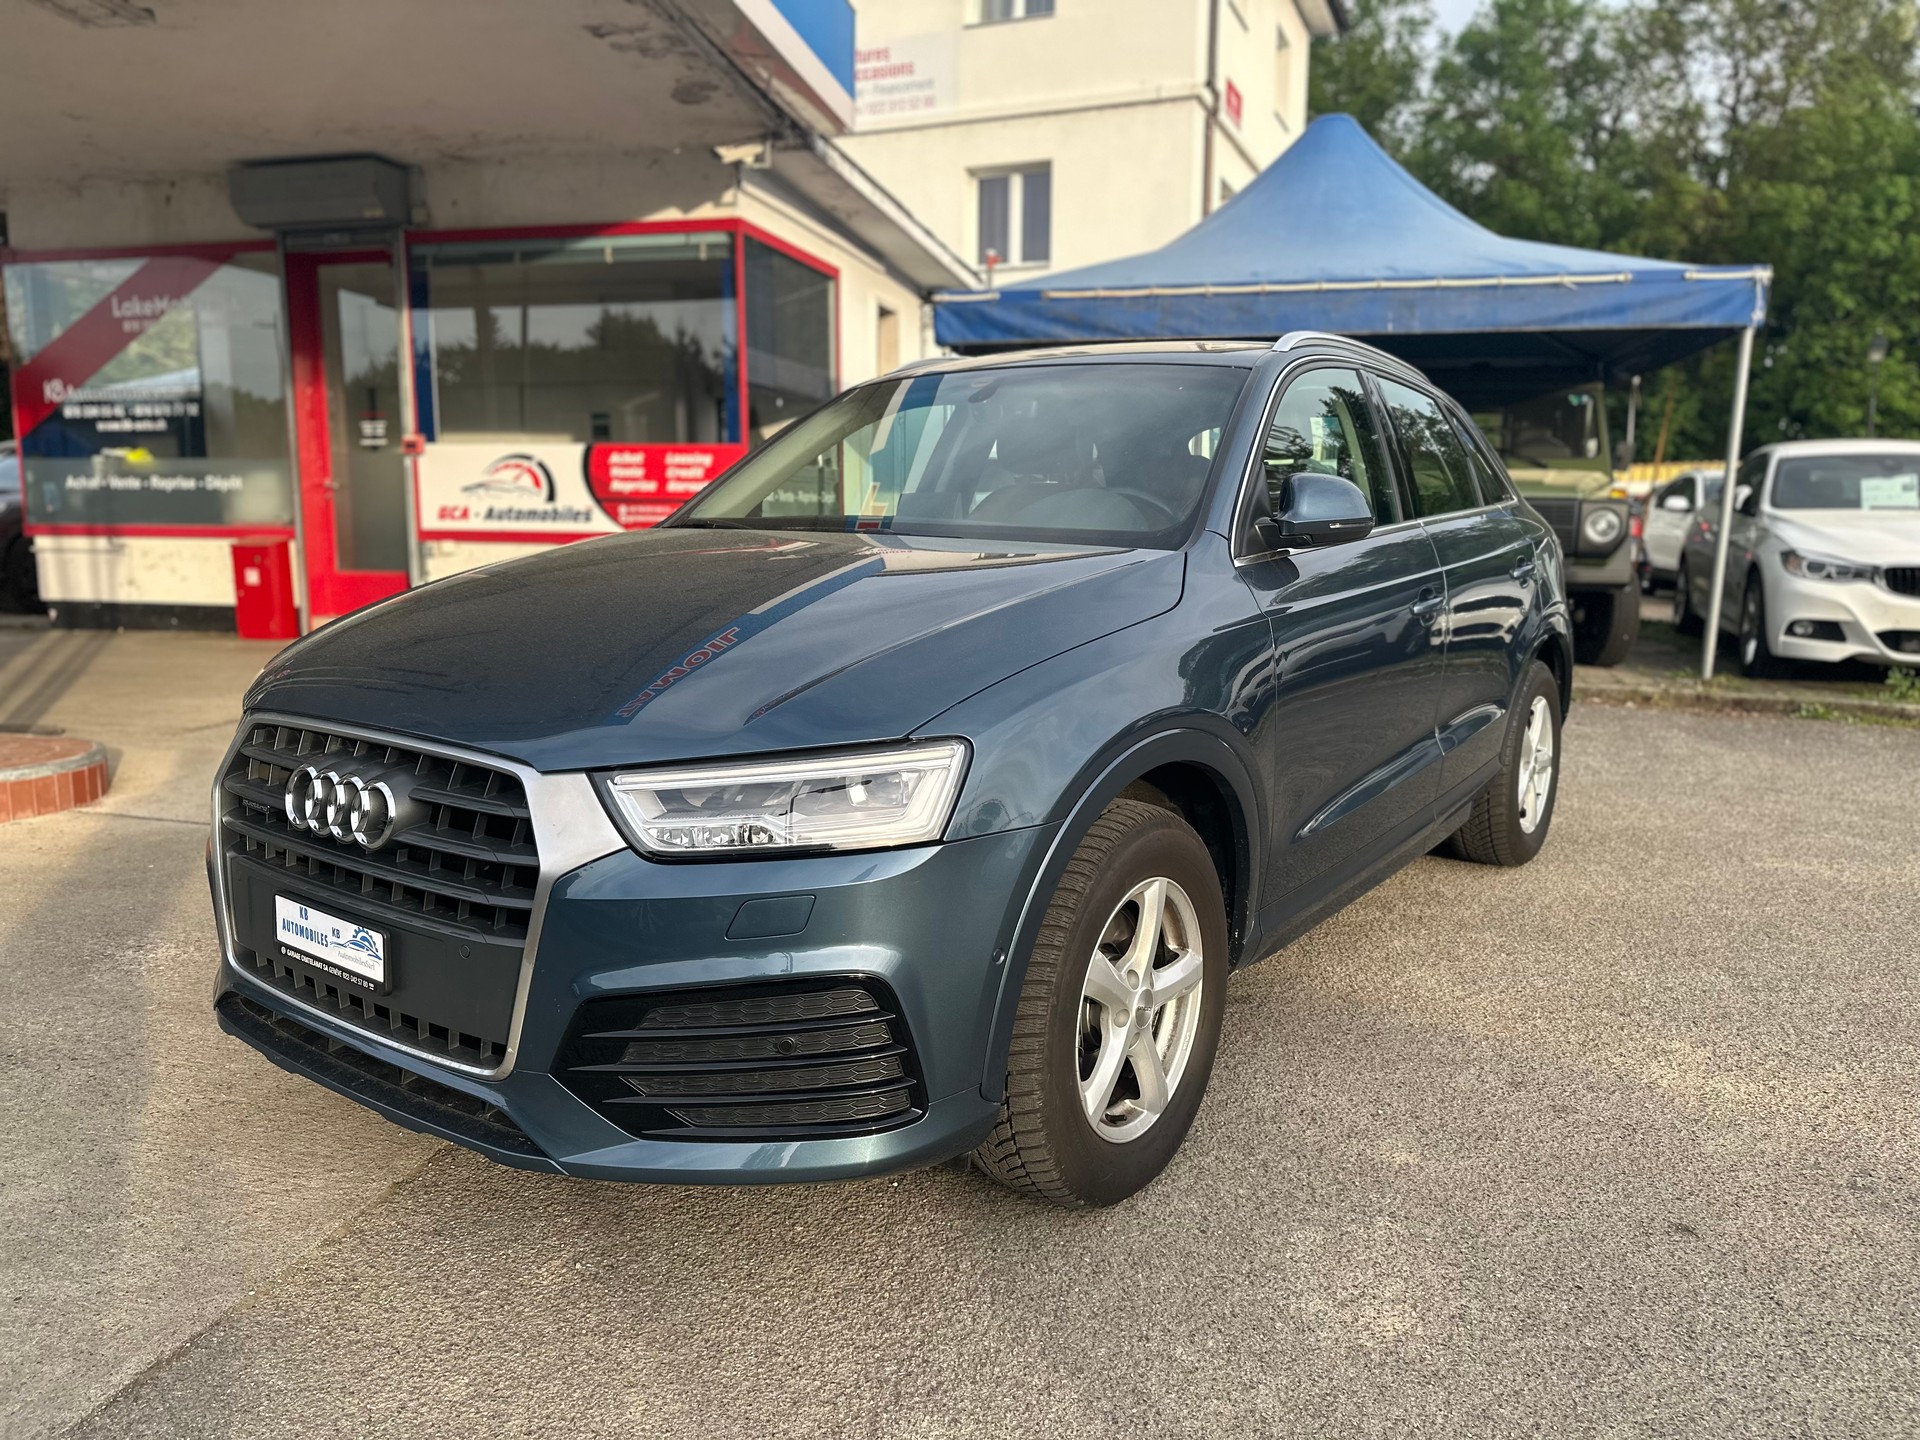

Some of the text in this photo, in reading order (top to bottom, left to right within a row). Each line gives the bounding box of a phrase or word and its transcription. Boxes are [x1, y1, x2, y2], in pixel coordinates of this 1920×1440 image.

[608, 451, 645, 465] Achat
[484, 505, 593, 523] Automobiles
[299, 906, 309, 920] KB
[282, 918, 329, 948] AUTOMOBILES
[331, 927, 341, 939] KB
